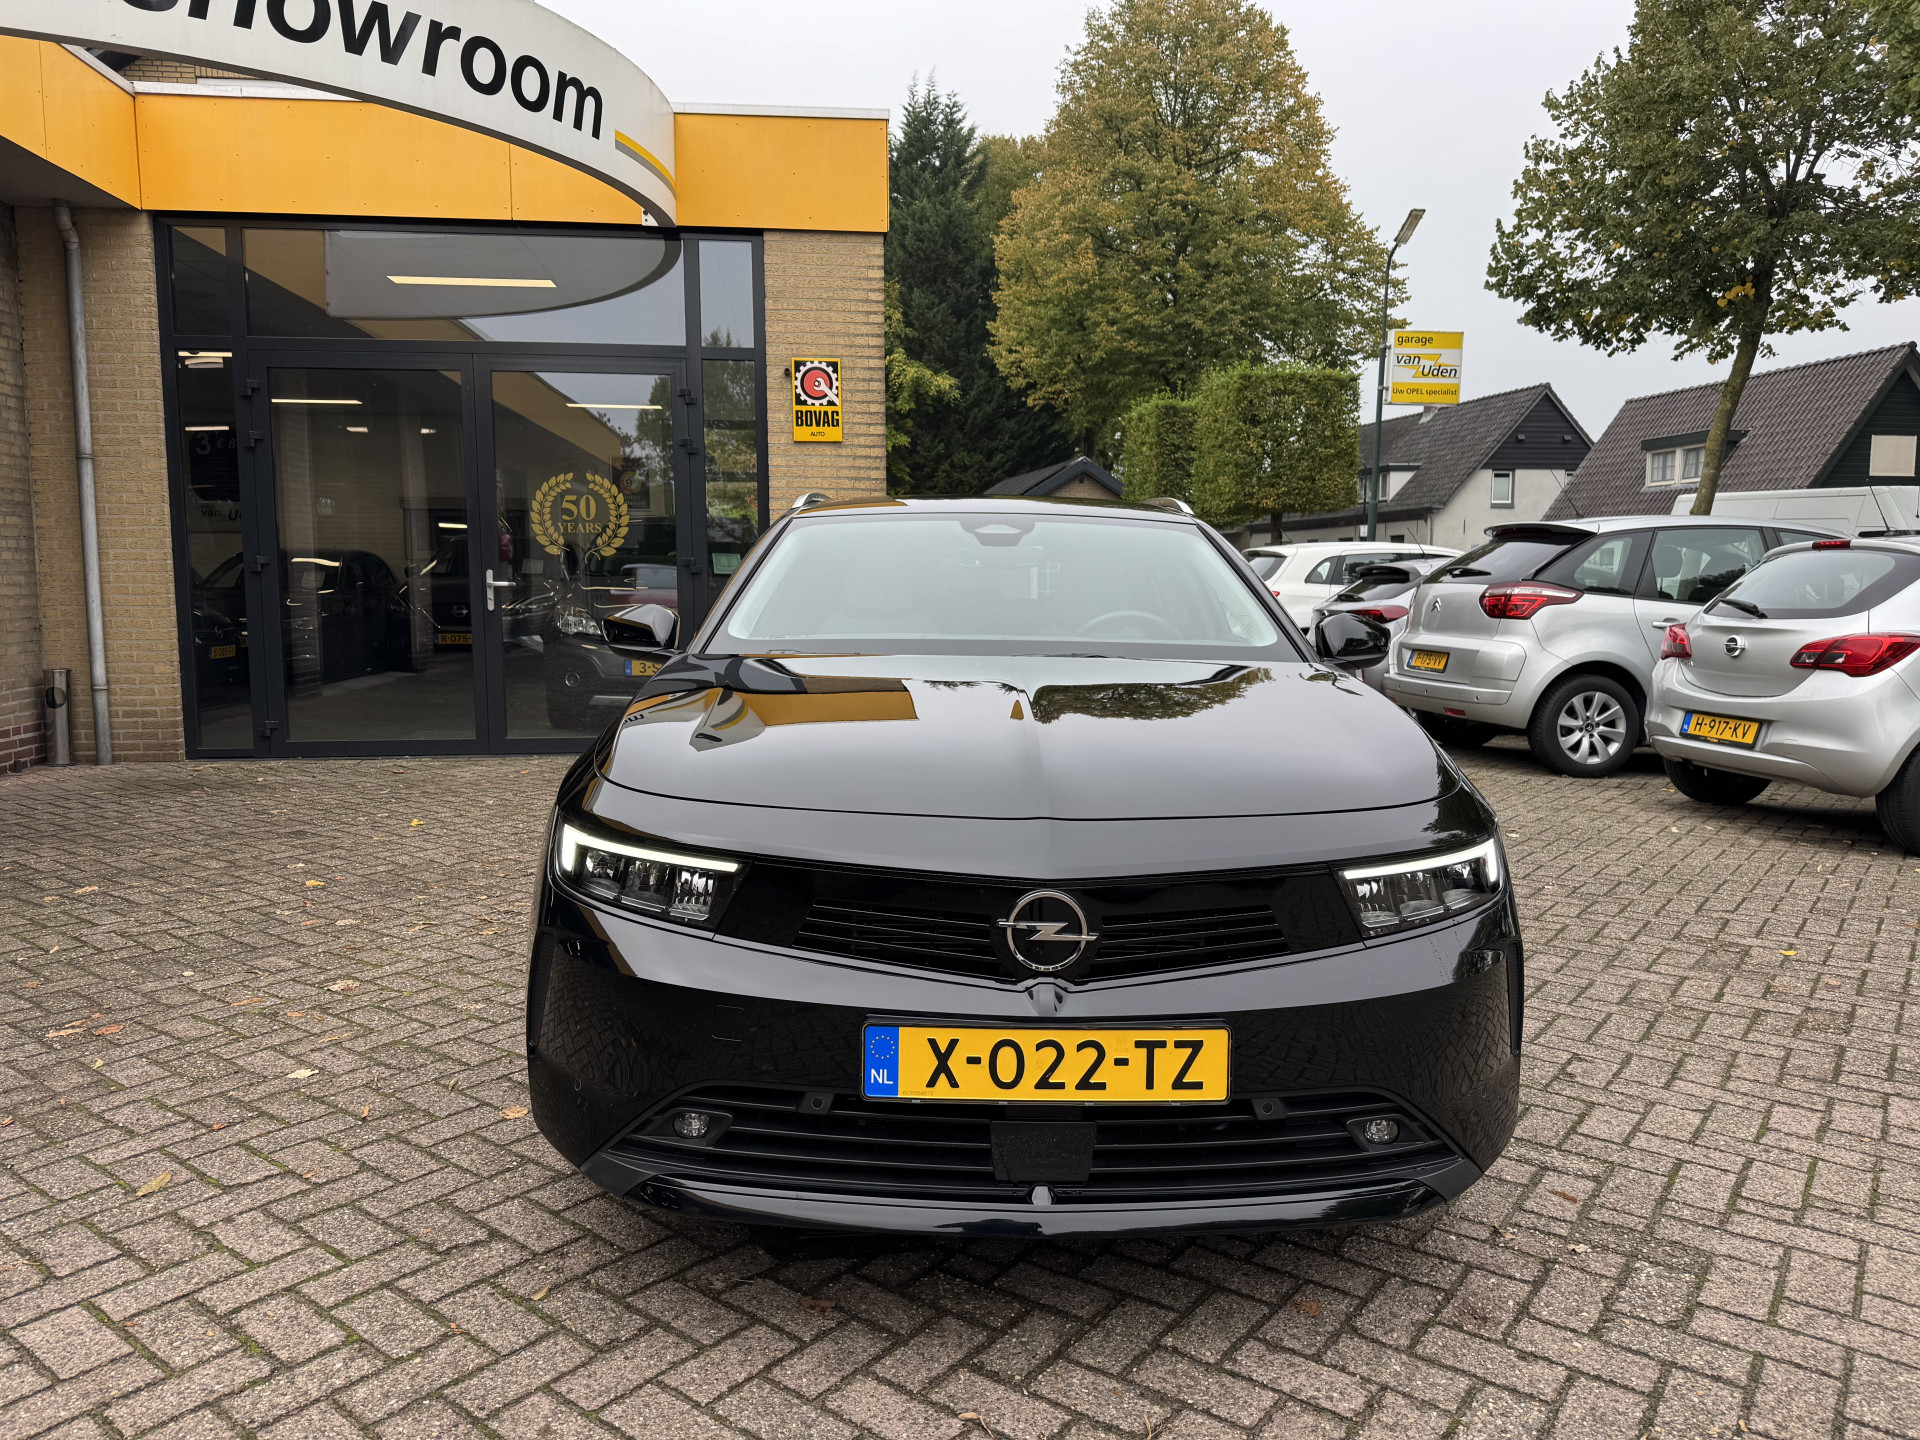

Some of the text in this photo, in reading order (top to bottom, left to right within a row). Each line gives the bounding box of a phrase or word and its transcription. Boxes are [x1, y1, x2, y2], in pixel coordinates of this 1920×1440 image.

[124, 0, 603, 140] owroom
[1397, 335, 1434, 347] garage
[1396, 355, 1421, 365] van
[1421, 365, 1458, 378] Uden
[1392, 387, 1405, 395] Uw
[1425, 388, 1457, 397] specialist
[795, 410, 840, 428] BOVAG
[561, 494, 597, 521] 50
[557, 522, 602, 533] YEARS
[1693, 716, 1752, 739] H-917-KV
[925, 1037, 1205, 1091] X-022-TZ
[870, 1068, 893, 1085] NL
